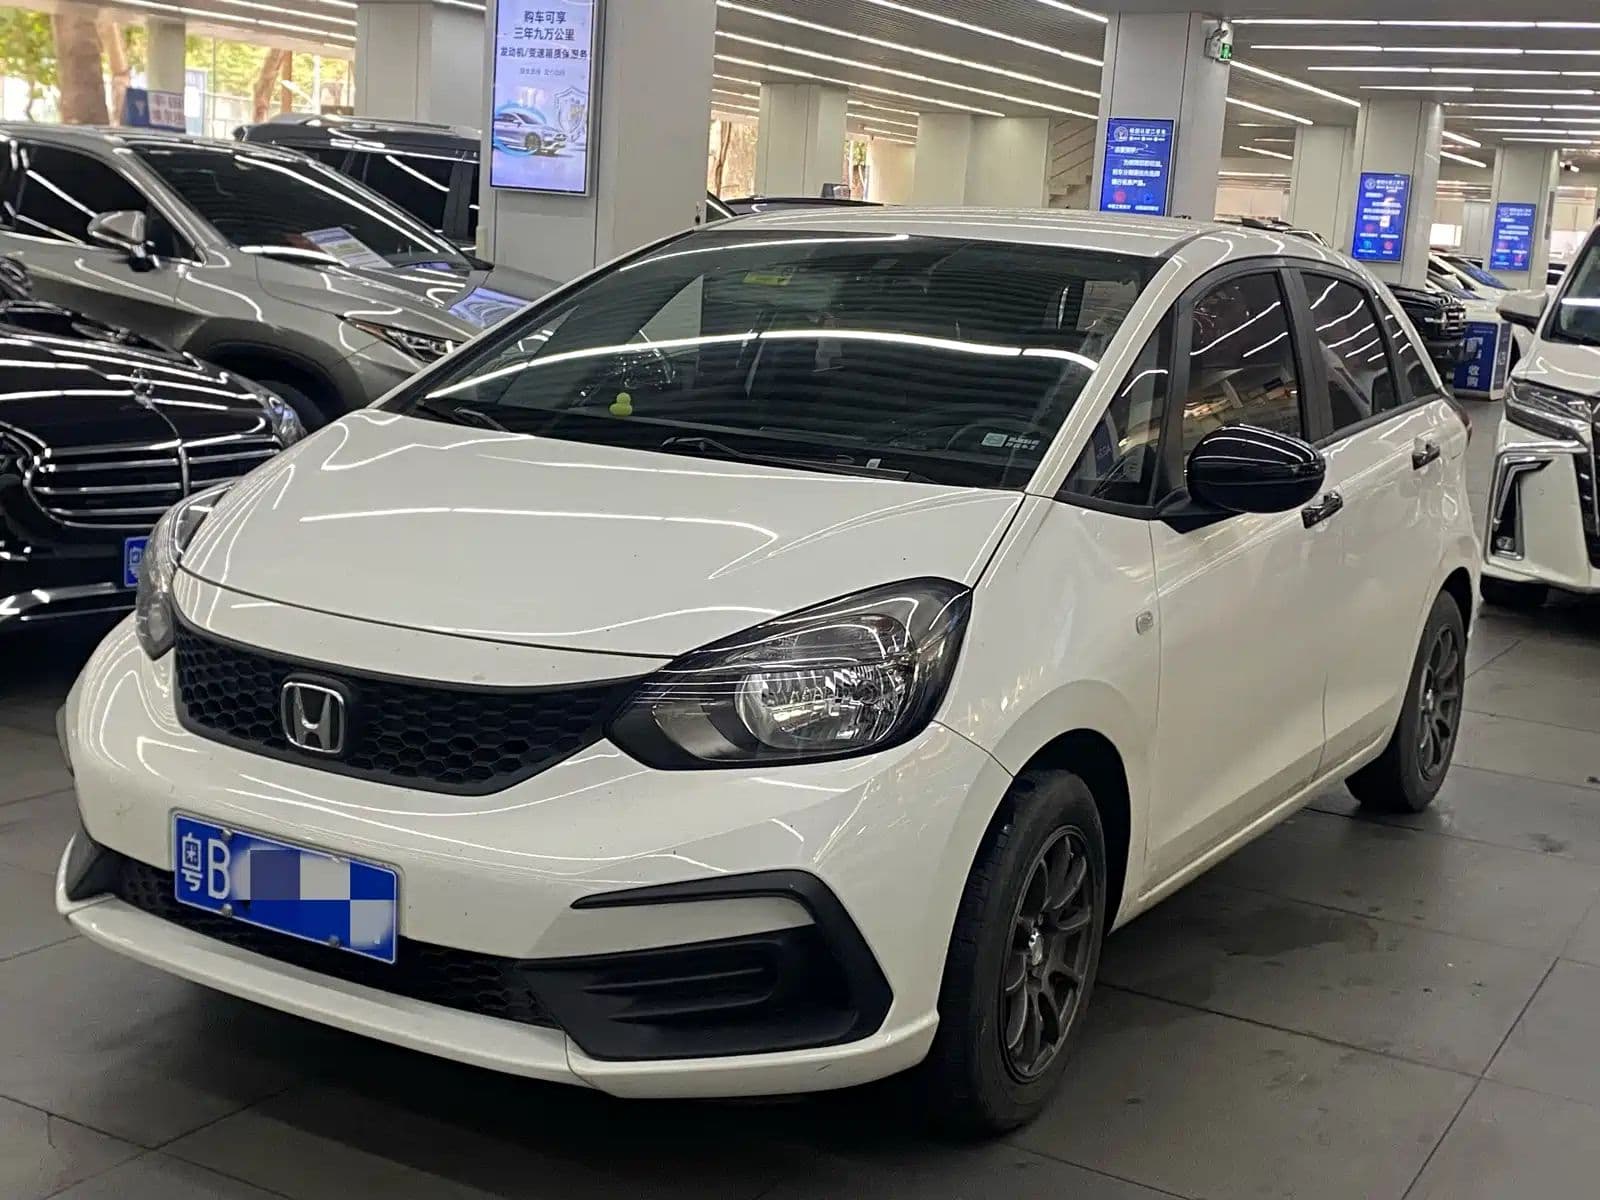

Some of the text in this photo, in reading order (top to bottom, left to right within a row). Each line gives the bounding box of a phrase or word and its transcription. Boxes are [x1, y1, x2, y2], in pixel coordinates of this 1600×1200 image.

[524, 10, 567, 24] 购车可享
[513, 27, 575, 41] 三年九万公里
